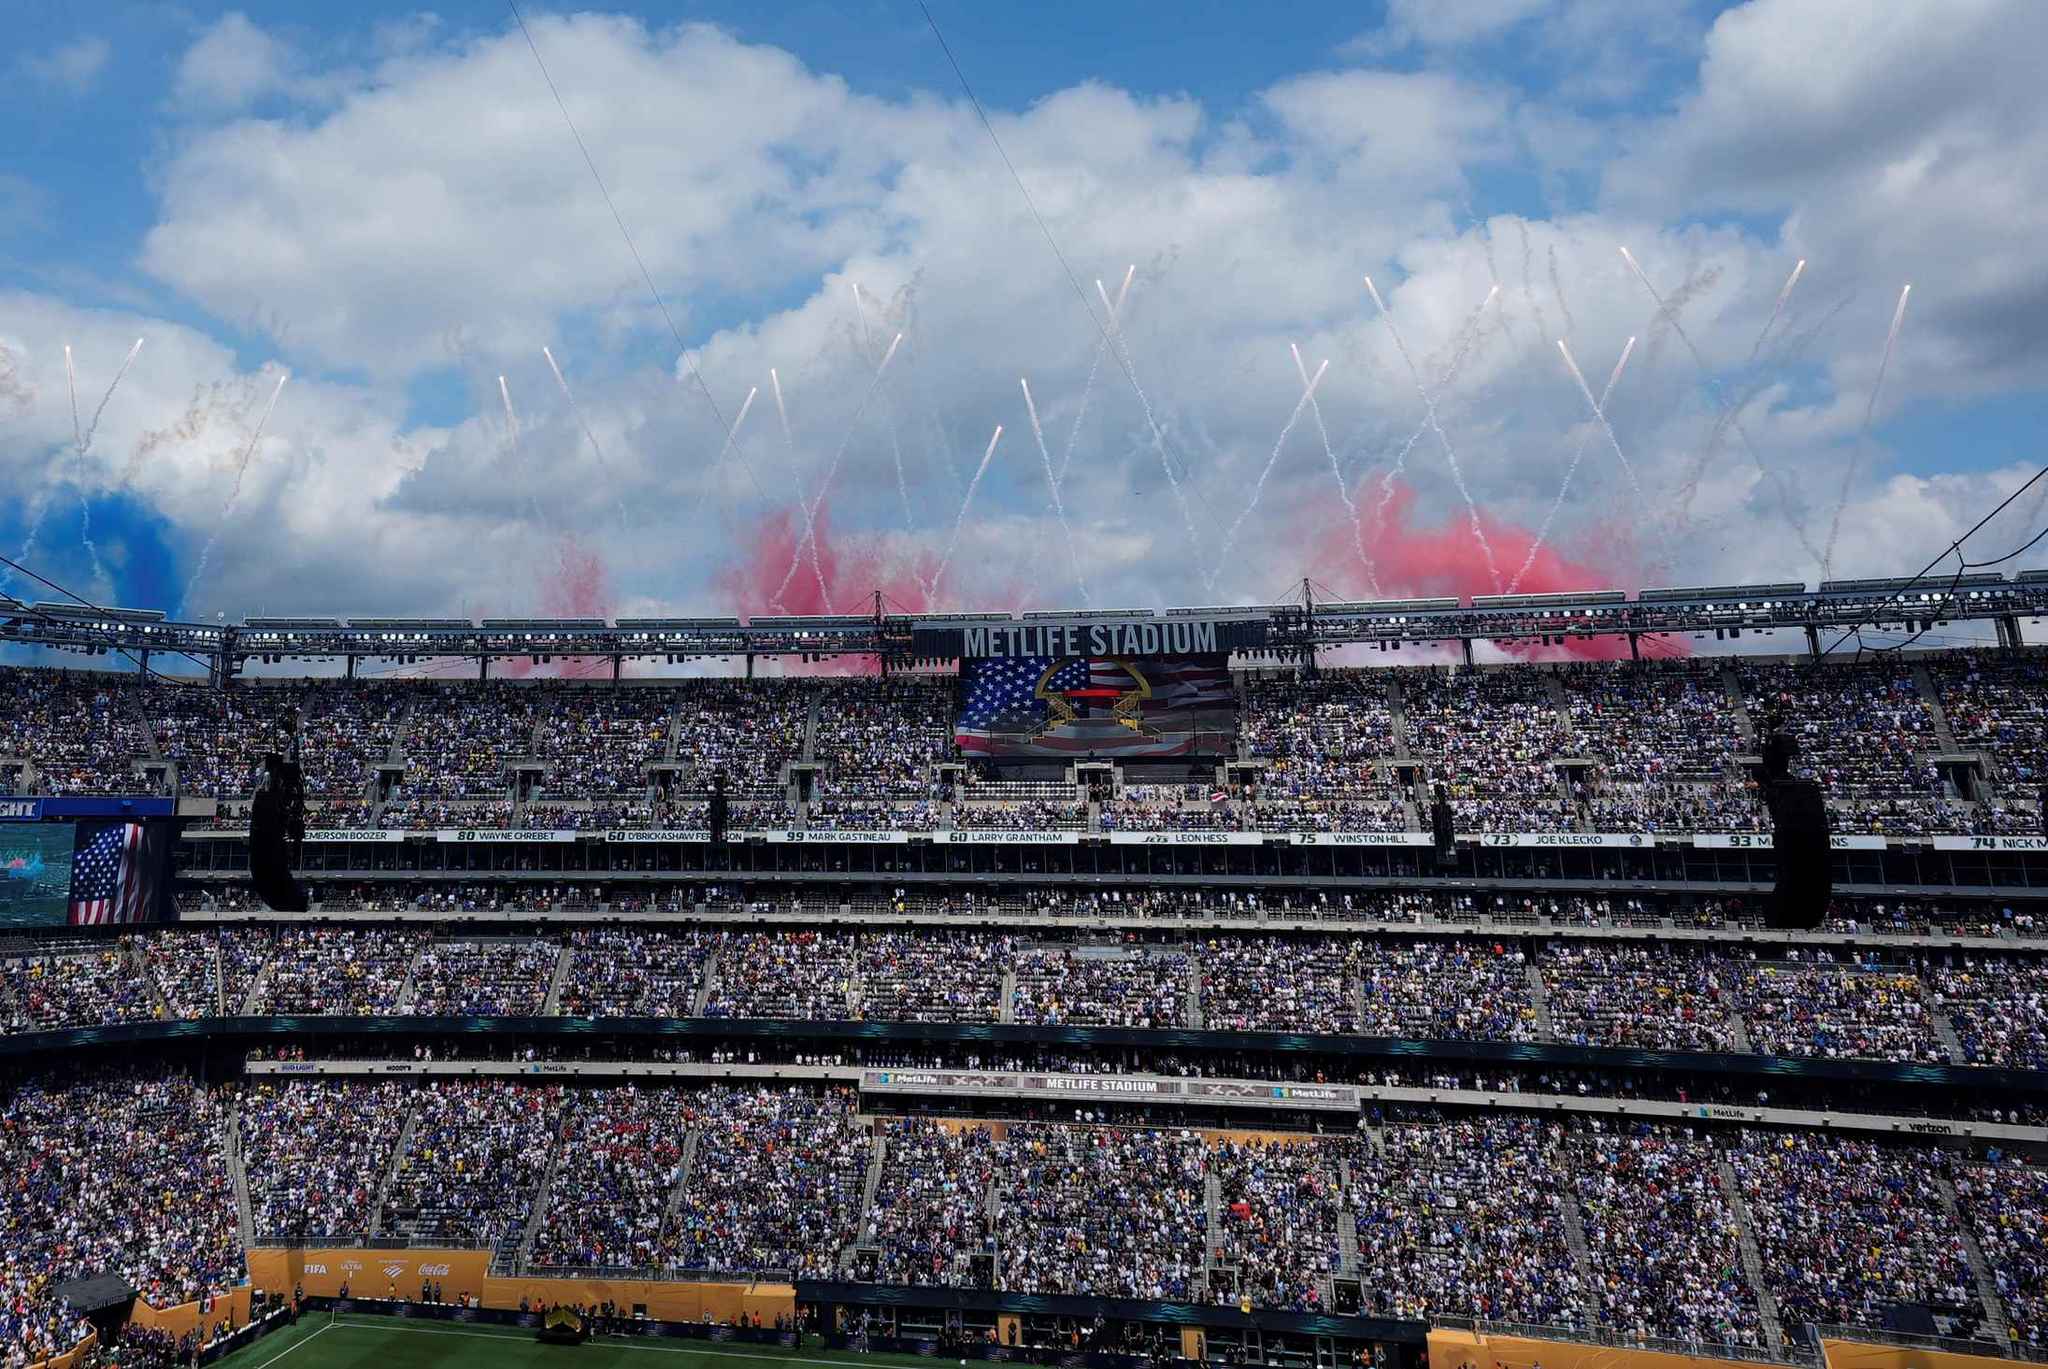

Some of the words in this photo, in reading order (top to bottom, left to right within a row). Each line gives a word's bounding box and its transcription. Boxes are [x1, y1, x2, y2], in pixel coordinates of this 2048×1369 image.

[963, 625, 1080, 657] METLIFE
[1090, 622, 1217, 656] STADIUM
[304, 831, 348, 840] EMERSON
[351, 831, 387, 840] BOOZER
[457, 831, 475, 840] 80
[479, 832, 512, 840] WAYNE
[514, 831, 555, 840] CHREBET
[607, 831, 625, 841] 60
[786, 831, 804, 841] 99
[808, 832, 836, 841] MARK
[838, 832, 890, 841] GASTINEAU
[949, 832, 967, 842] 60
[972, 833, 1003, 841] LARRY
[1006, 833, 1062, 842] GRANTHAM
[1176, 834, 1201, 842] LEON
[1203, 834, 1228, 842] HESS
[1298, 833, 1316, 843] 75
[1334, 834, 1384, 843] WINSTON
[1385, 834, 1408, 843] HILL
[1492, 835, 1511, 845] 73
[1535, 835, 1557, 845] JOE
[1558, 835, 1602, 845] KLECKO
[1729, 836, 1750, 847] 93
[1970, 837, 1996, 848] 74
[2003, 839, 2033, 849] NICK
[897, 1074, 937, 1084] MetLife
[1046, 1078, 1098, 1090] METLIFE
[1101, 1081, 1157, 1091] STADIUM
[1292, 1089, 1337, 1099] MetLife
[1713, 1108, 1744, 1118] MetLife
[1909, 1122, 1952, 1134] verizon
[304, 1264, 327, 1274] FIFA
